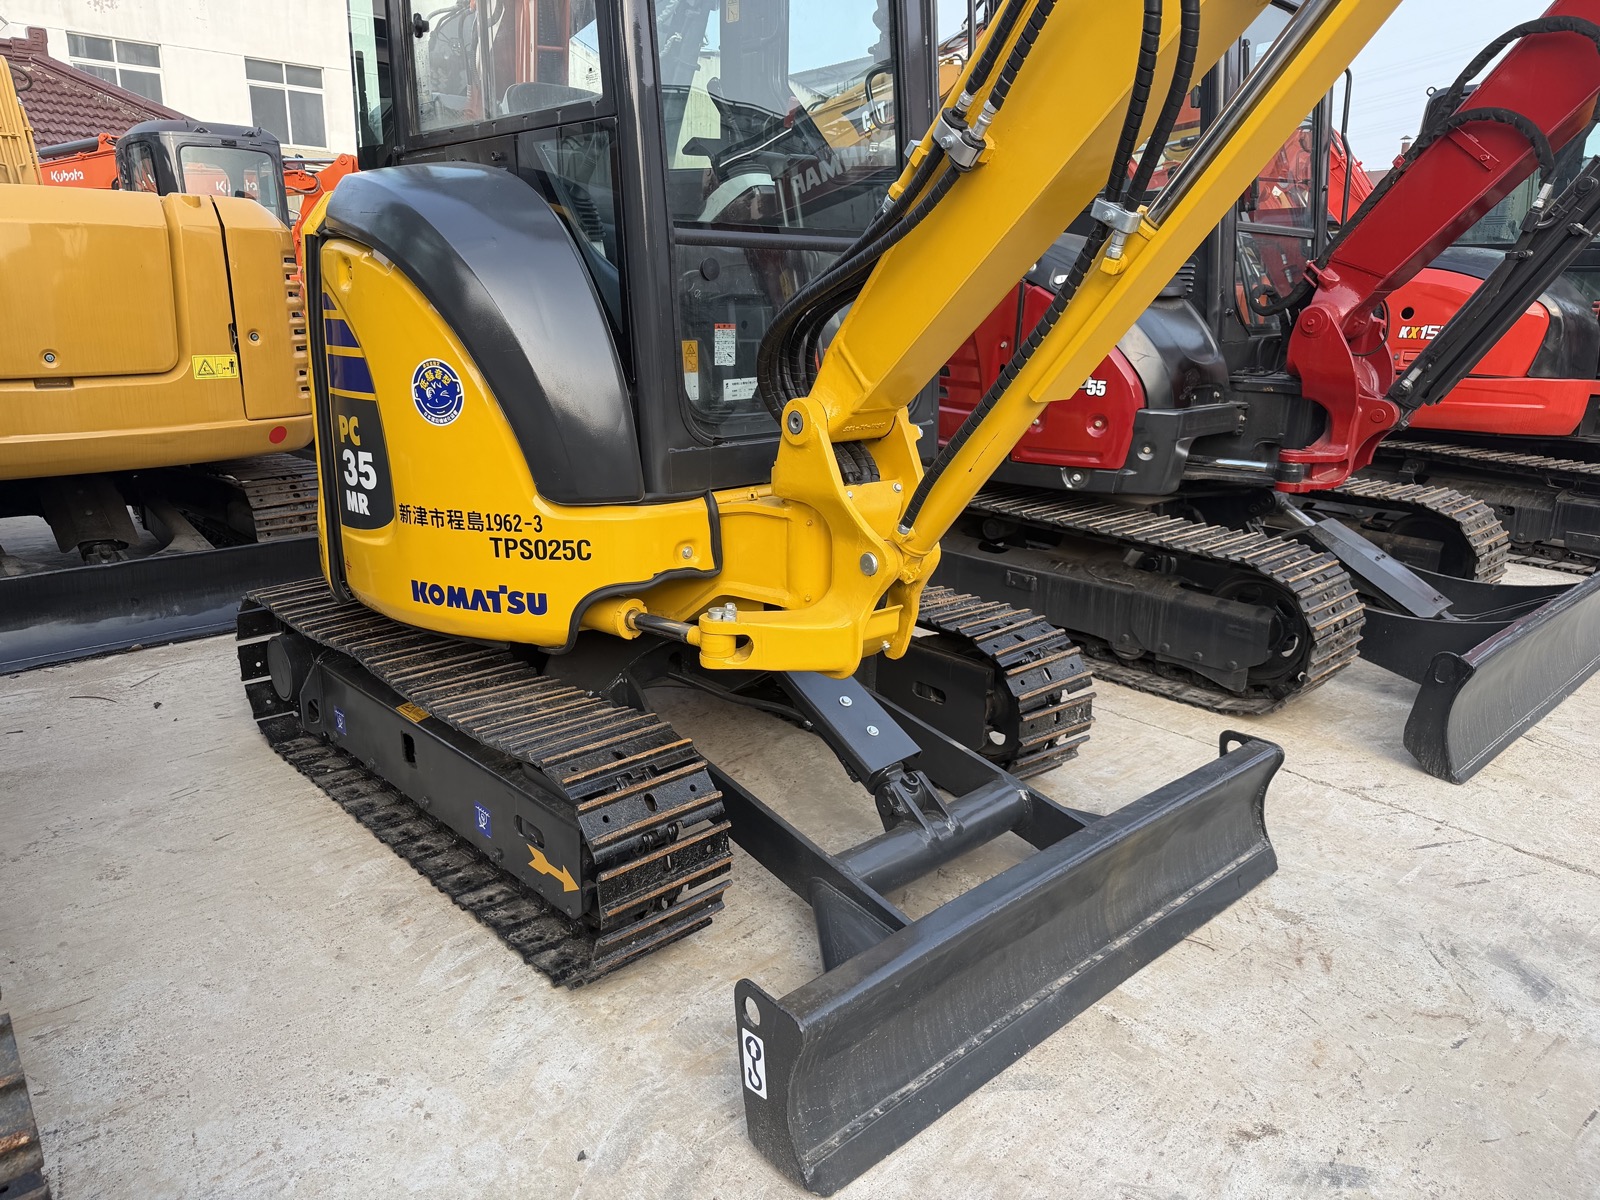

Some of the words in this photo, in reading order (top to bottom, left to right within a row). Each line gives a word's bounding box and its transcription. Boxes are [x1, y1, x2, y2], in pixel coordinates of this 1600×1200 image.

[51, 169, 84, 183] Kubota
[216, 179, 257, 193] Kuta
[1398, 325, 1444, 340] KX15
[338, 414, 361, 446] PC
[342, 448, 377, 490] 35
[345, 489, 371, 516] MR
[411, 579, 548, 616] KOMATSU
